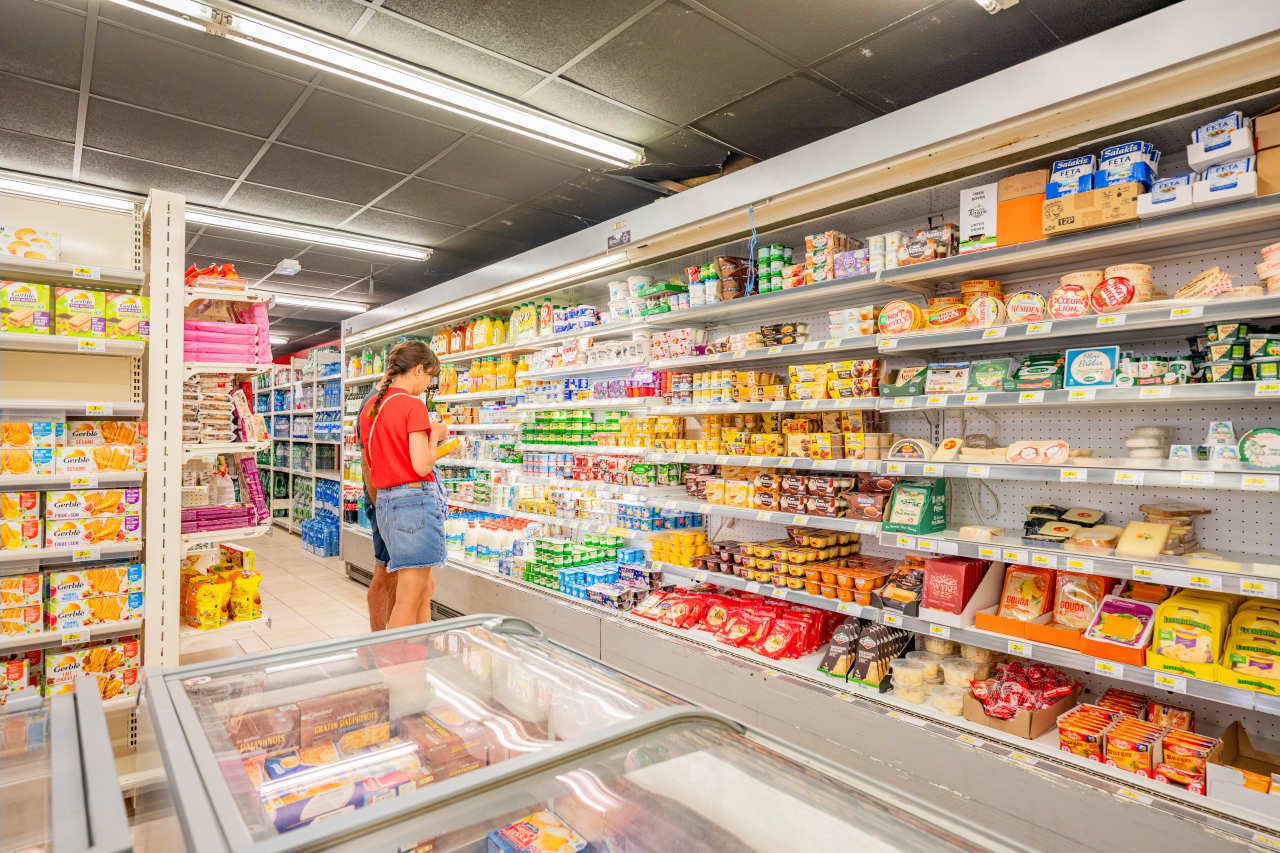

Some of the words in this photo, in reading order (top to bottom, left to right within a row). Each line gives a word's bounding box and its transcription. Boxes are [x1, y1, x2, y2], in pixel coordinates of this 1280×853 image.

[1206, 121, 1229, 132] FETA
[1104, 144, 1138, 158] Salakis
[1057, 158, 1088, 169] Salakis
[1108, 156, 1131, 166] FETA
[1060, 168, 1081, 176] FETA
[1216, 164, 1239, 173] FETA
[1160, 180, 1180, 188] FETA
[54, 501, 81, 509] Gerblé
[53, 529, 81, 537] Gerblé
[57, 583, 84, 591] Gerblé
[1006, 595, 1029, 606] GOUDA
[1060, 601, 1085, 611] GOUDA
[57, 611, 85, 619] Gerblé
[53, 664, 81, 673] Gerblé
